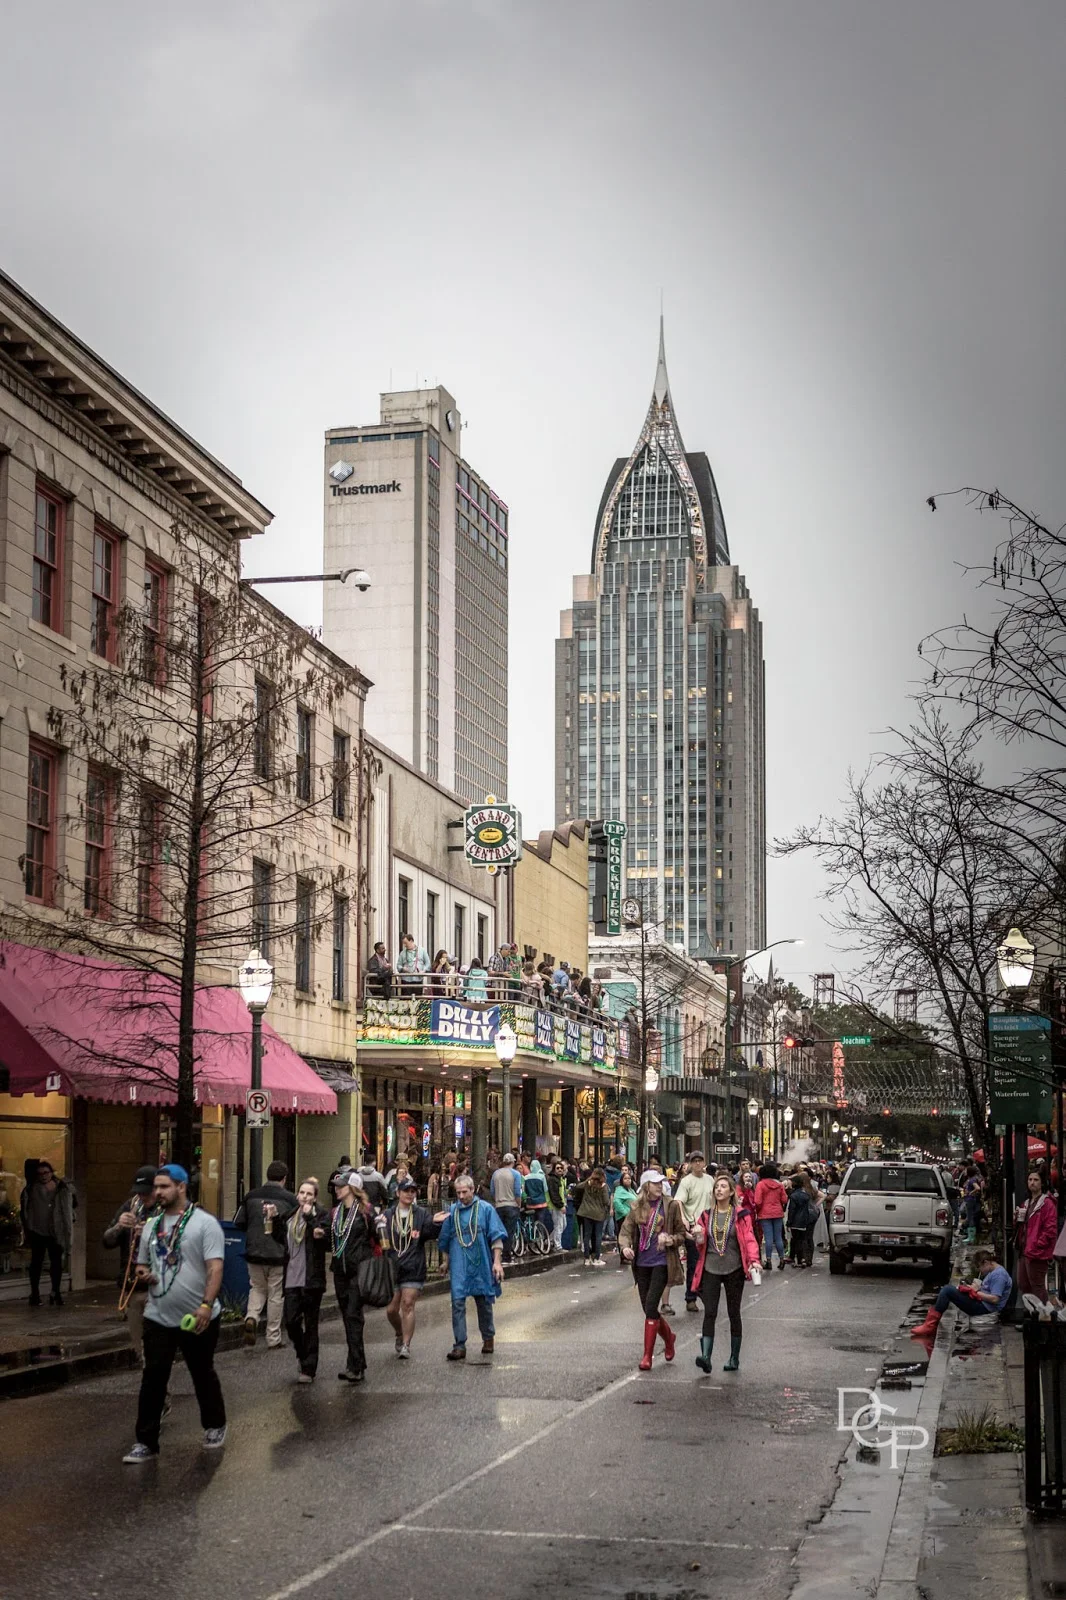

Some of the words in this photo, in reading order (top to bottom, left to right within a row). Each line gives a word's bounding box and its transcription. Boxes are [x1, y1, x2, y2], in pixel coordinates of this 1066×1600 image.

[329, 480, 402, 497] Trustmark
[471, 810, 510, 826] GRAND
[469, 843, 514, 861] CENTRAL
[610, 837, 620, 926] CROCKMIERS
[439, 1003, 495, 1025] DILLY
[438, 1020, 494, 1041] DILLY
[993, 1034, 1020, 1042] Saenger
[842, 1036, 866, 1045] Joachim
[994, 1077, 1017, 1085] Square
